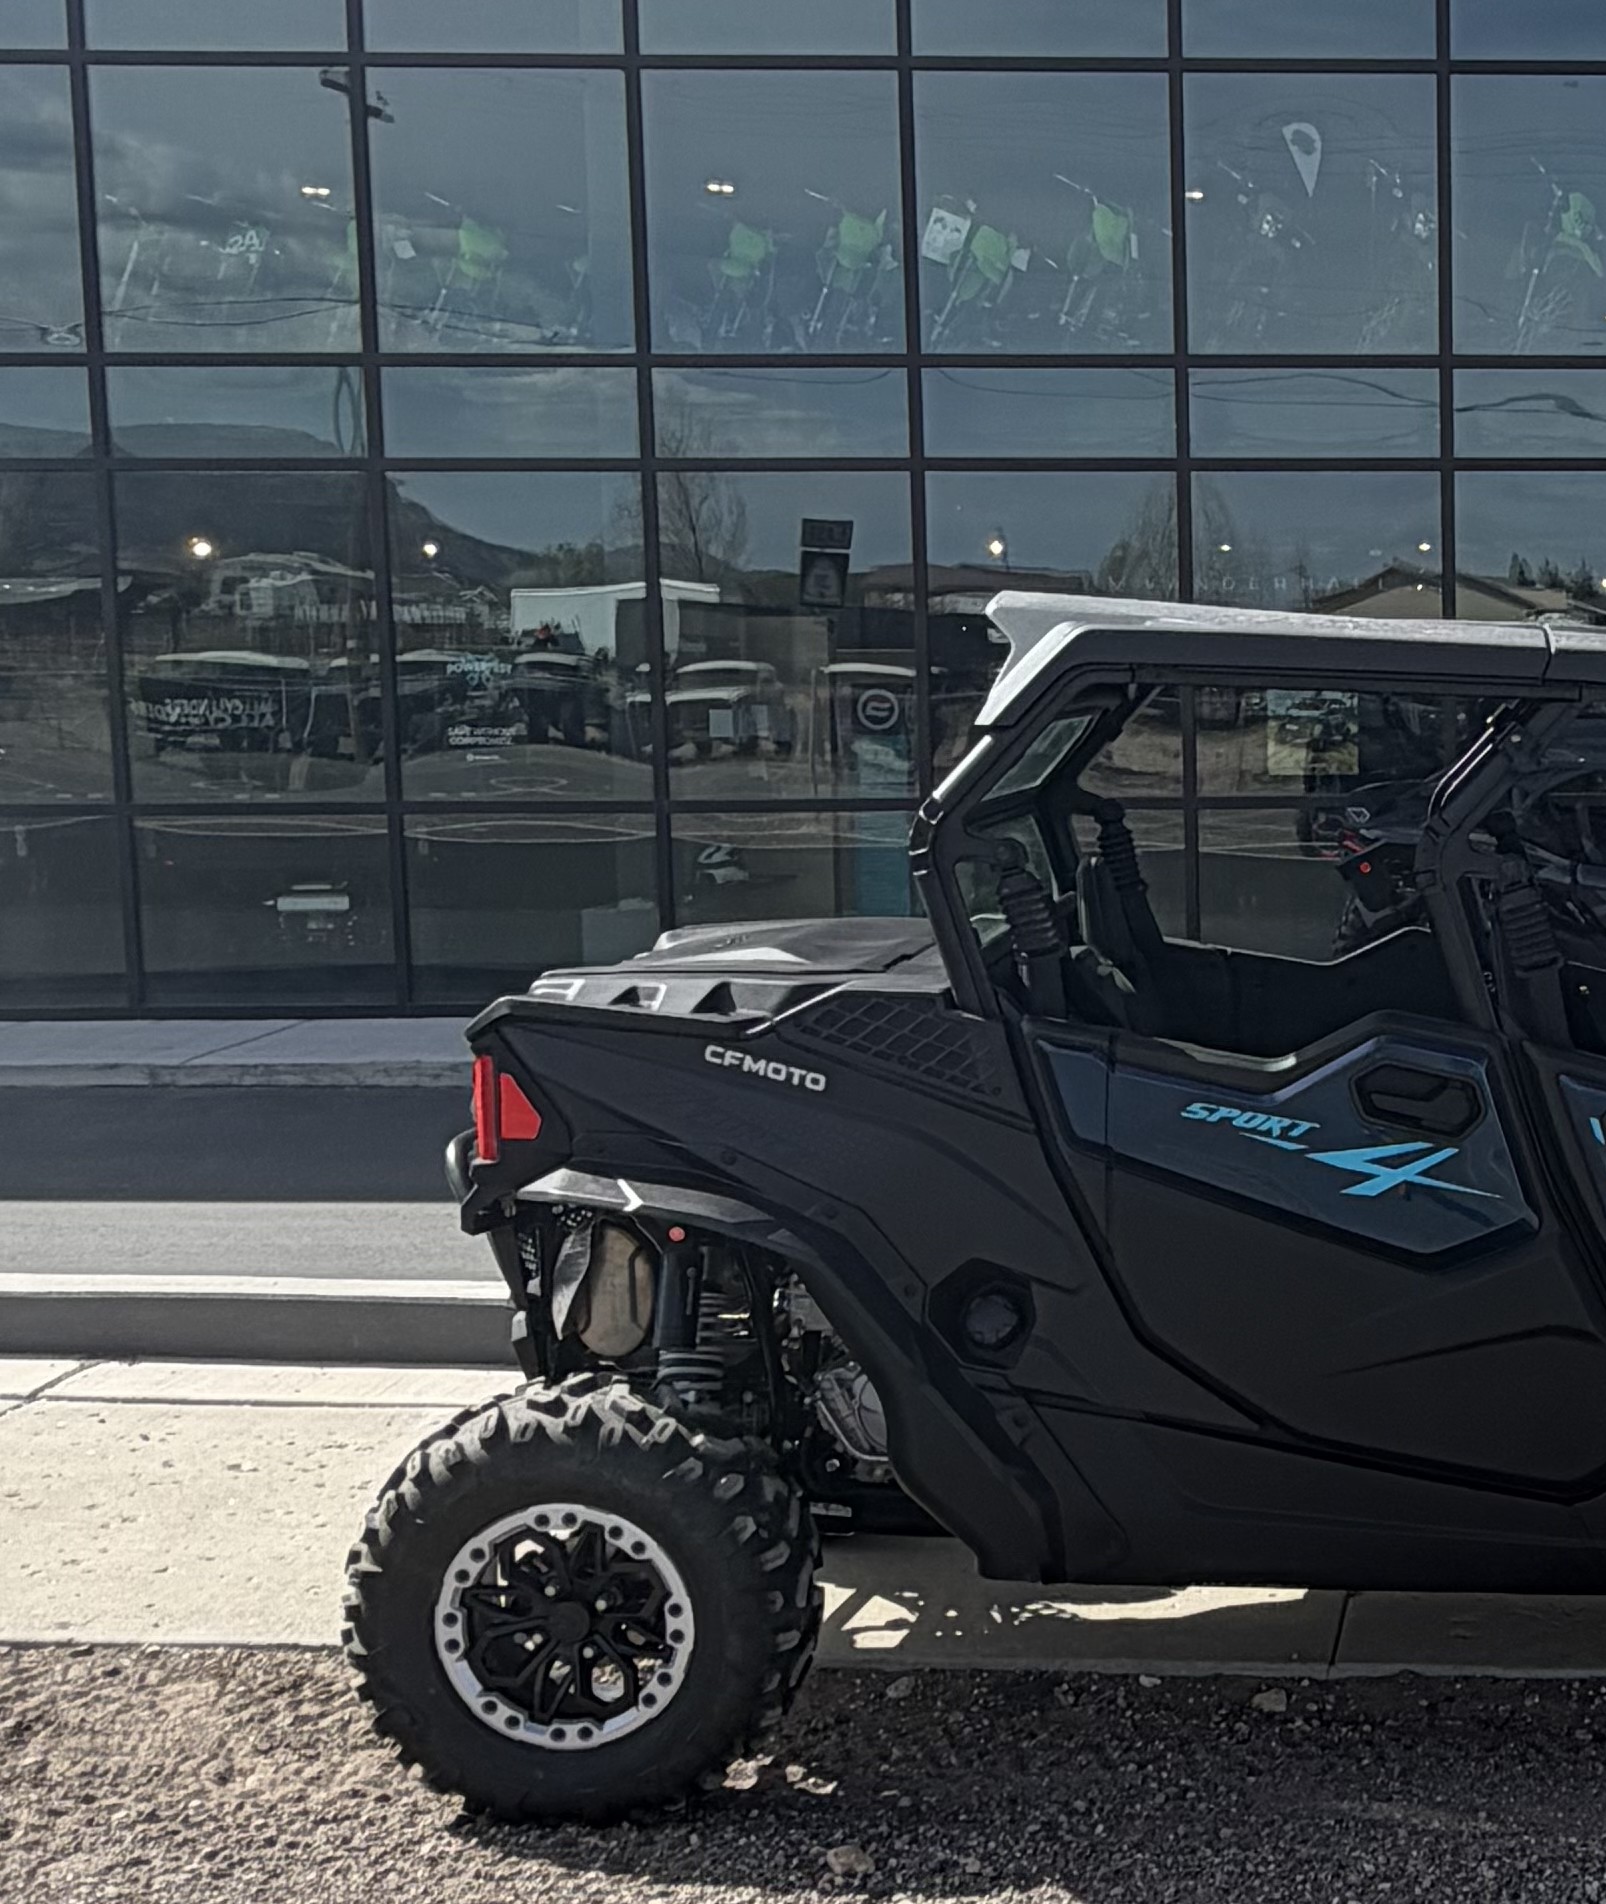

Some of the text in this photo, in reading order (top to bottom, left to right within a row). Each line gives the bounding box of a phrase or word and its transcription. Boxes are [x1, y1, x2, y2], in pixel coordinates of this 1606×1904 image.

[704, 1043, 827, 1092] CFMOTO
[1180, 1102, 1503, 1197] SPORT 4
